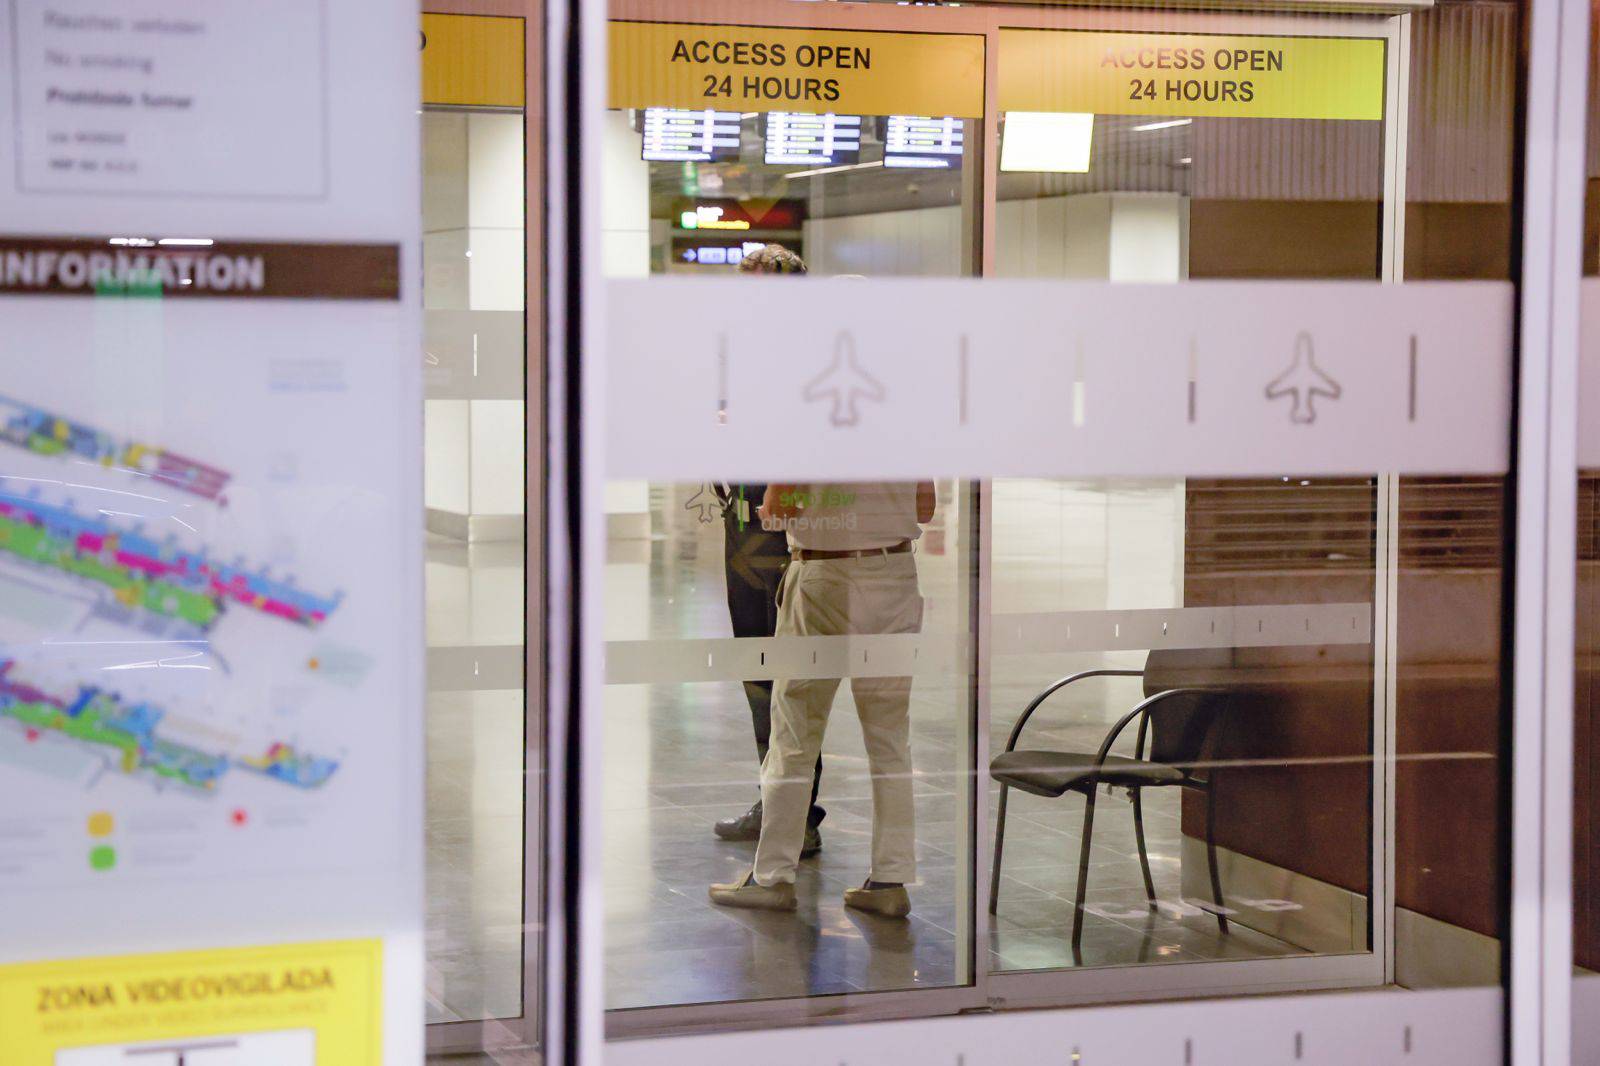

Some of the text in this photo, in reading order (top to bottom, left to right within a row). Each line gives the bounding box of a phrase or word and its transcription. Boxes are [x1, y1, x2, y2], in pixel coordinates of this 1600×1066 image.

[671, 39, 871, 70] ACCESS OPEN
[1101, 47, 1283, 72] ACCESS OPEN
[703, 75, 841, 101] 24 HOURS
[1129, 79, 1255, 103] 24 HOURS
[0, 251, 265, 289] NFORMATION
[37, 967, 336, 1012] ZONA VIDEOVIGILADA
